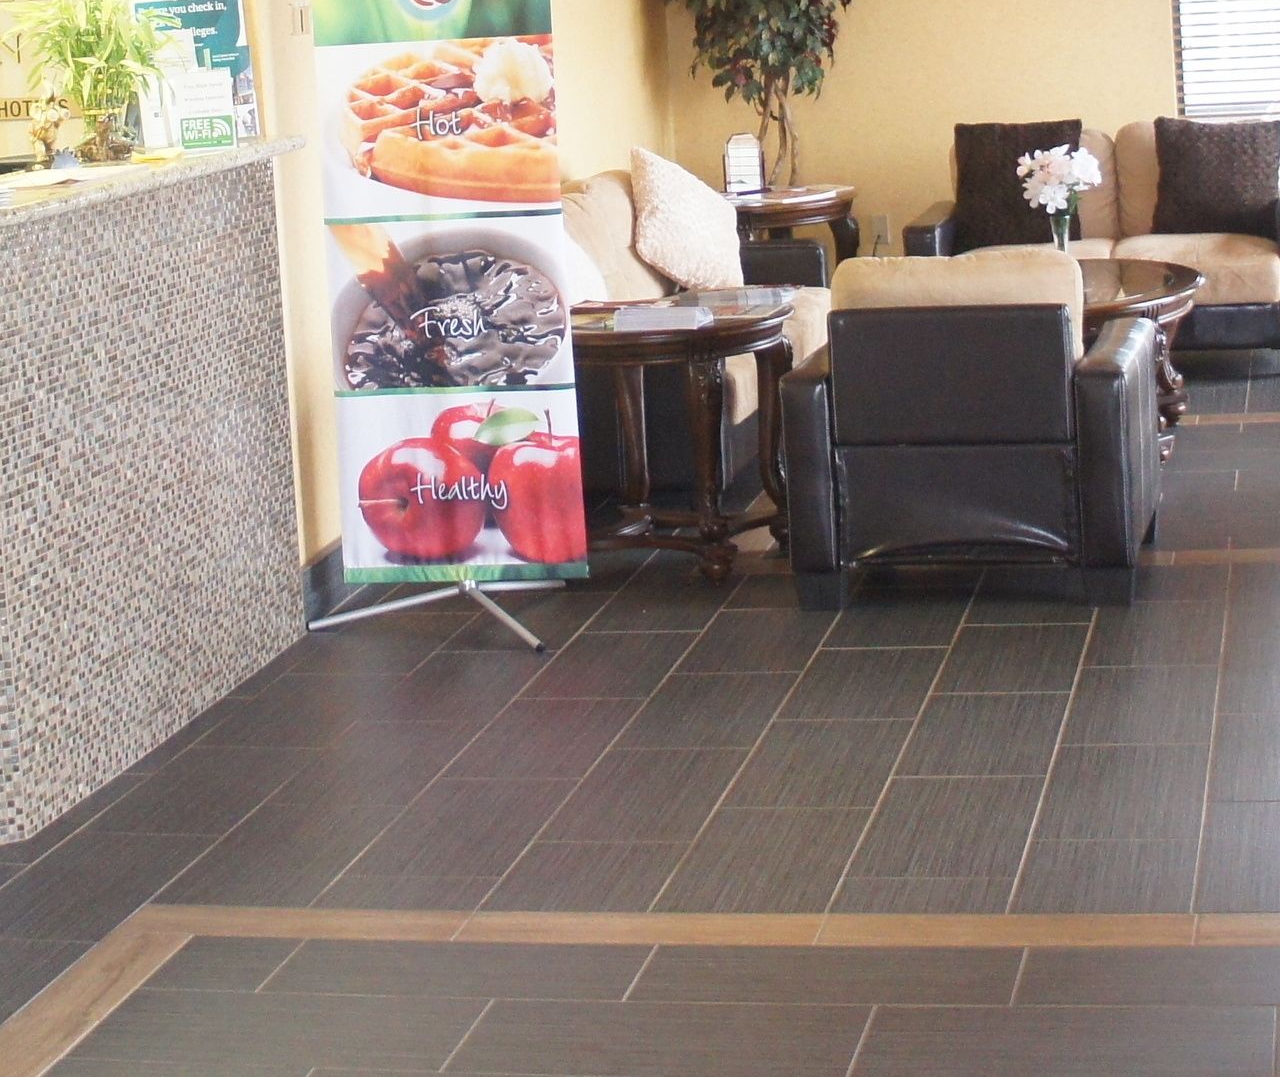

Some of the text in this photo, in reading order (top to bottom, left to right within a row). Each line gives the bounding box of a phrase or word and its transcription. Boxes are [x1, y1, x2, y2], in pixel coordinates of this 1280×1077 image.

[168, 5, 187, 16] you
[188, 1, 214, 13] check
[215, 0, 228, 11] in,
[182, 118, 211, 130] FREE
[412, 107, 462, 141] Hot
[409, 305, 488, 339] Fresh
[410, 472, 509, 511] Healthy
